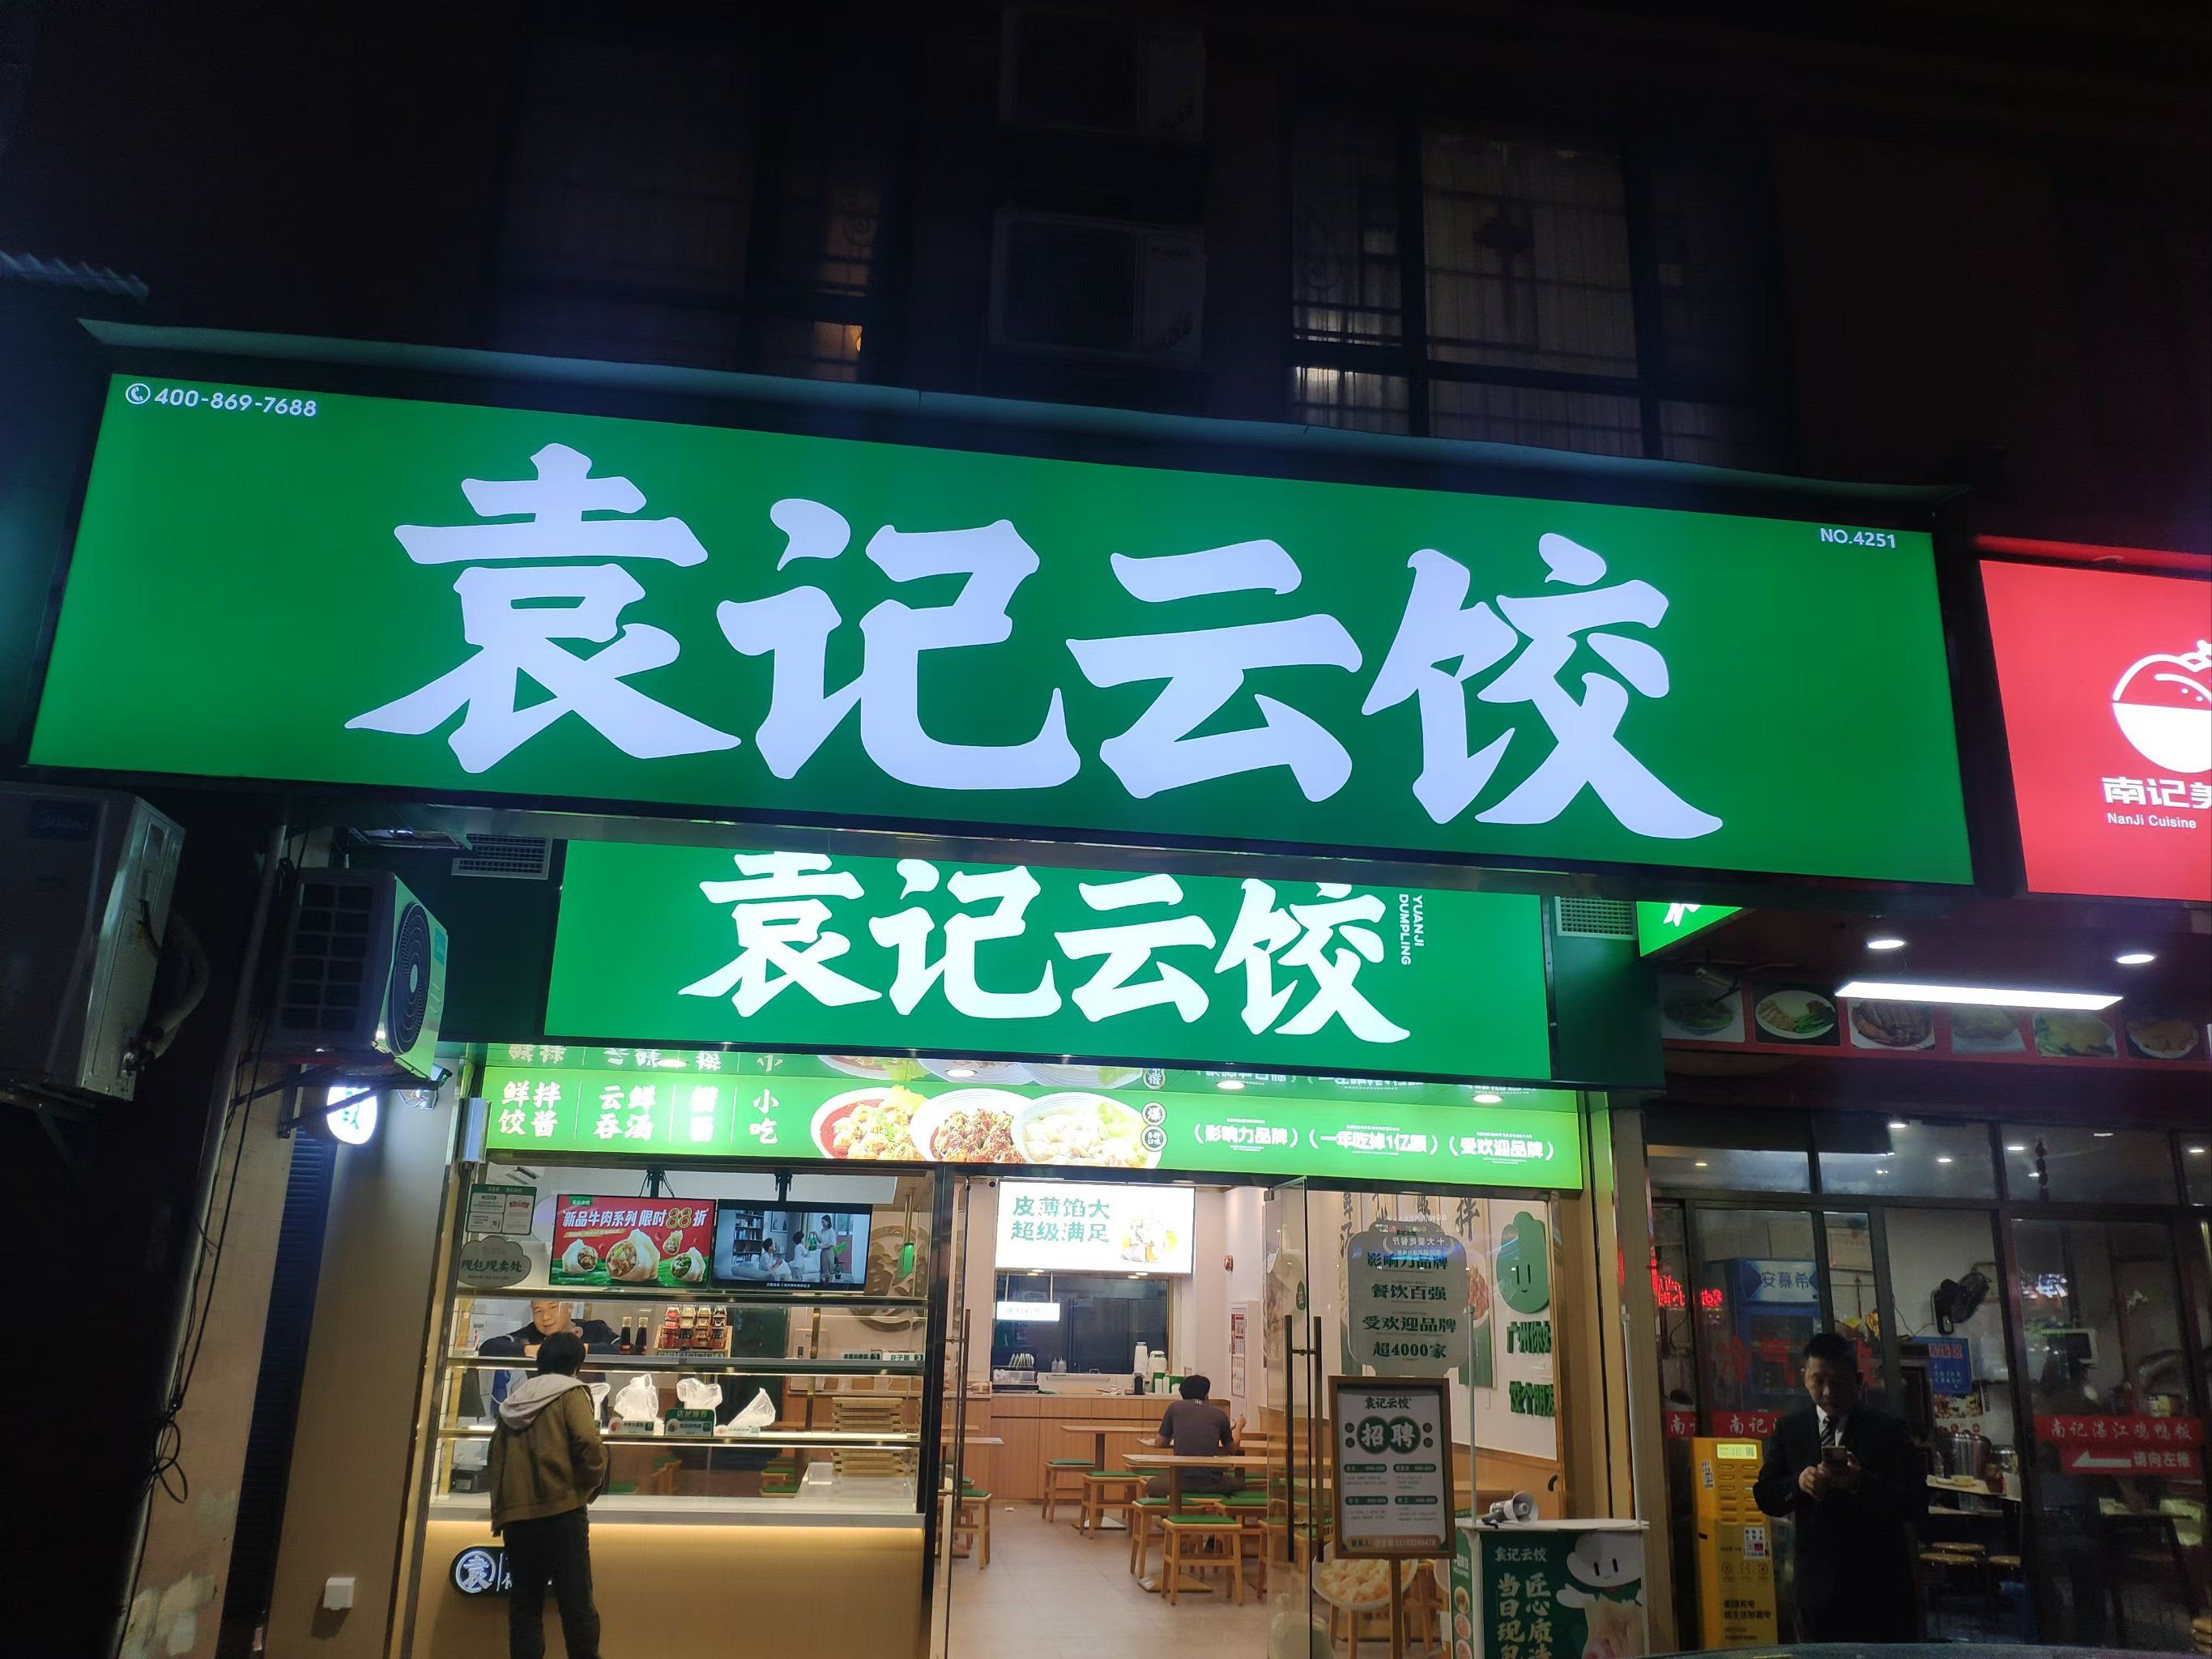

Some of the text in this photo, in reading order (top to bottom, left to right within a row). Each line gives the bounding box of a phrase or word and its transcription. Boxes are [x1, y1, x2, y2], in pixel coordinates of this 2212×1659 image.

[154, 388, 317, 416] 400-869-7688
[1820, 527, 1896, 548] NO.4251
[345, 443, 1724, 838] 袁记云饺
[2107, 812, 2197, 830] NanJi Cuisine
[1399, 893, 1411, 966] DUMPLING
[1412, 894, 1424, 947] YUANJI
[677, 851, 1411, 1043] 袁记云饺
[748, 1088, 779, 1145] 小吃
[1012, 1196, 1110, 1219] 皮薄馅大
[1011, 1221, 1110, 1243] 超级满足
[1371, 1284, 1447, 1301] 餐饮百强
[1362, 1316, 1456, 1333] 受欢迎品牌
[1373, 1341, 1447, 1359] 超4000家
[1364, 1397, 1411, 1410] 袁记云饺
[1362, 1422, 1416, 1448] 招聘
[1494, 1546, 1548, 1563] 袁记云饺
